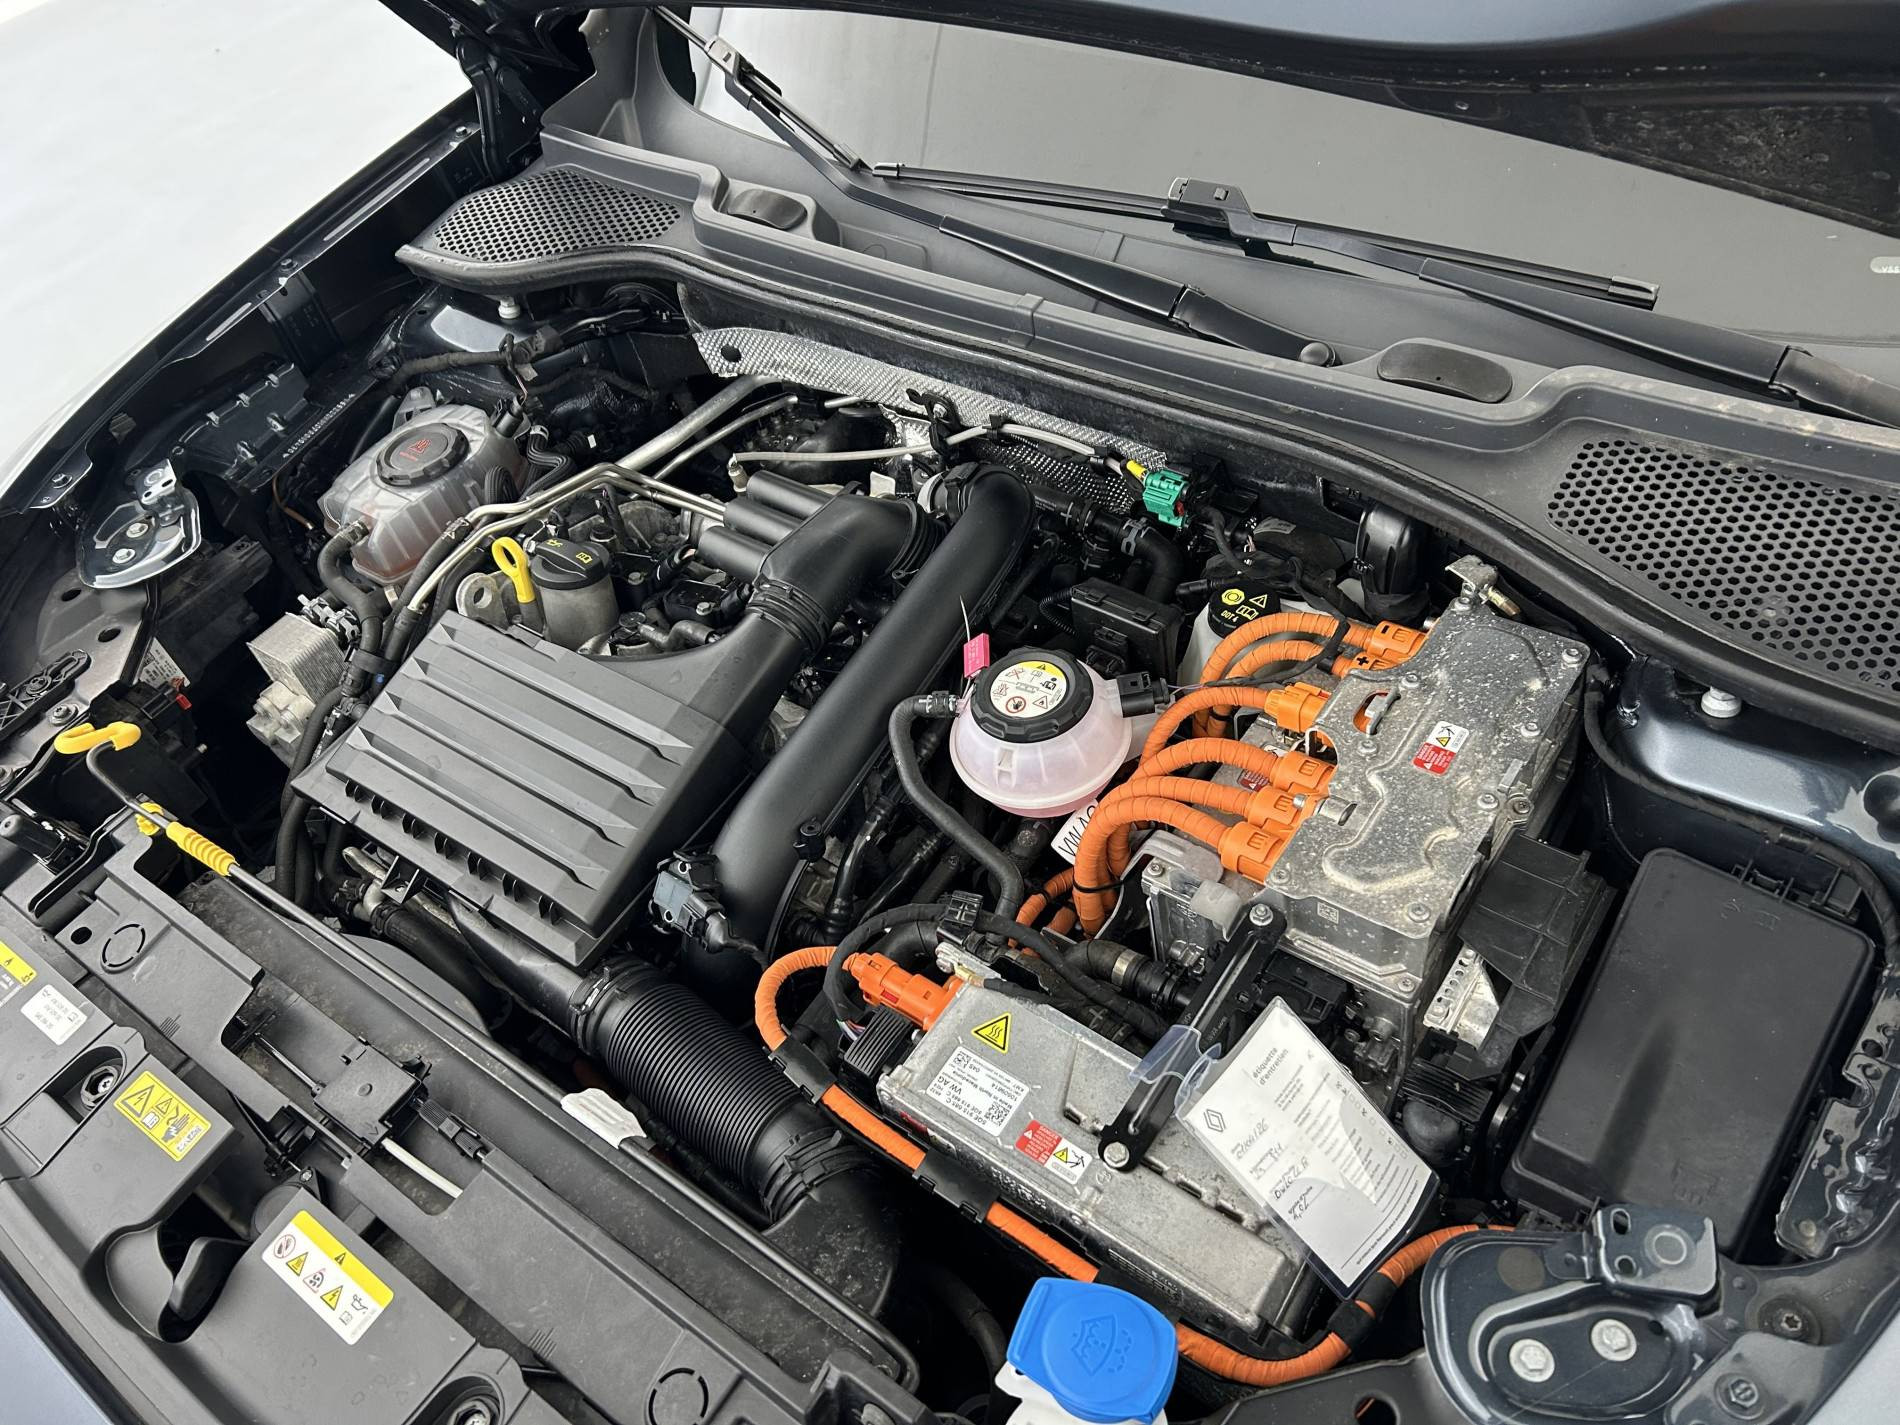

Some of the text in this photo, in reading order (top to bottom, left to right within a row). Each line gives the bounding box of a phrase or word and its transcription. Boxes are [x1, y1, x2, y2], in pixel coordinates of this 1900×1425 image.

[1220, 608, 1238, 623] DOT 4
[1252, 1047, 1278, 1078] étiquette
[1259, 1049, 1289, 1085] d'entretien
[937, 1075, 950, 1086] AG
[951, 1069, 978, 1088] Macedonia
[949, 1083, 962, 1094] VW
[977, 1085, 992, 1097] North
[998, 1098, 1012, 1109] Made
